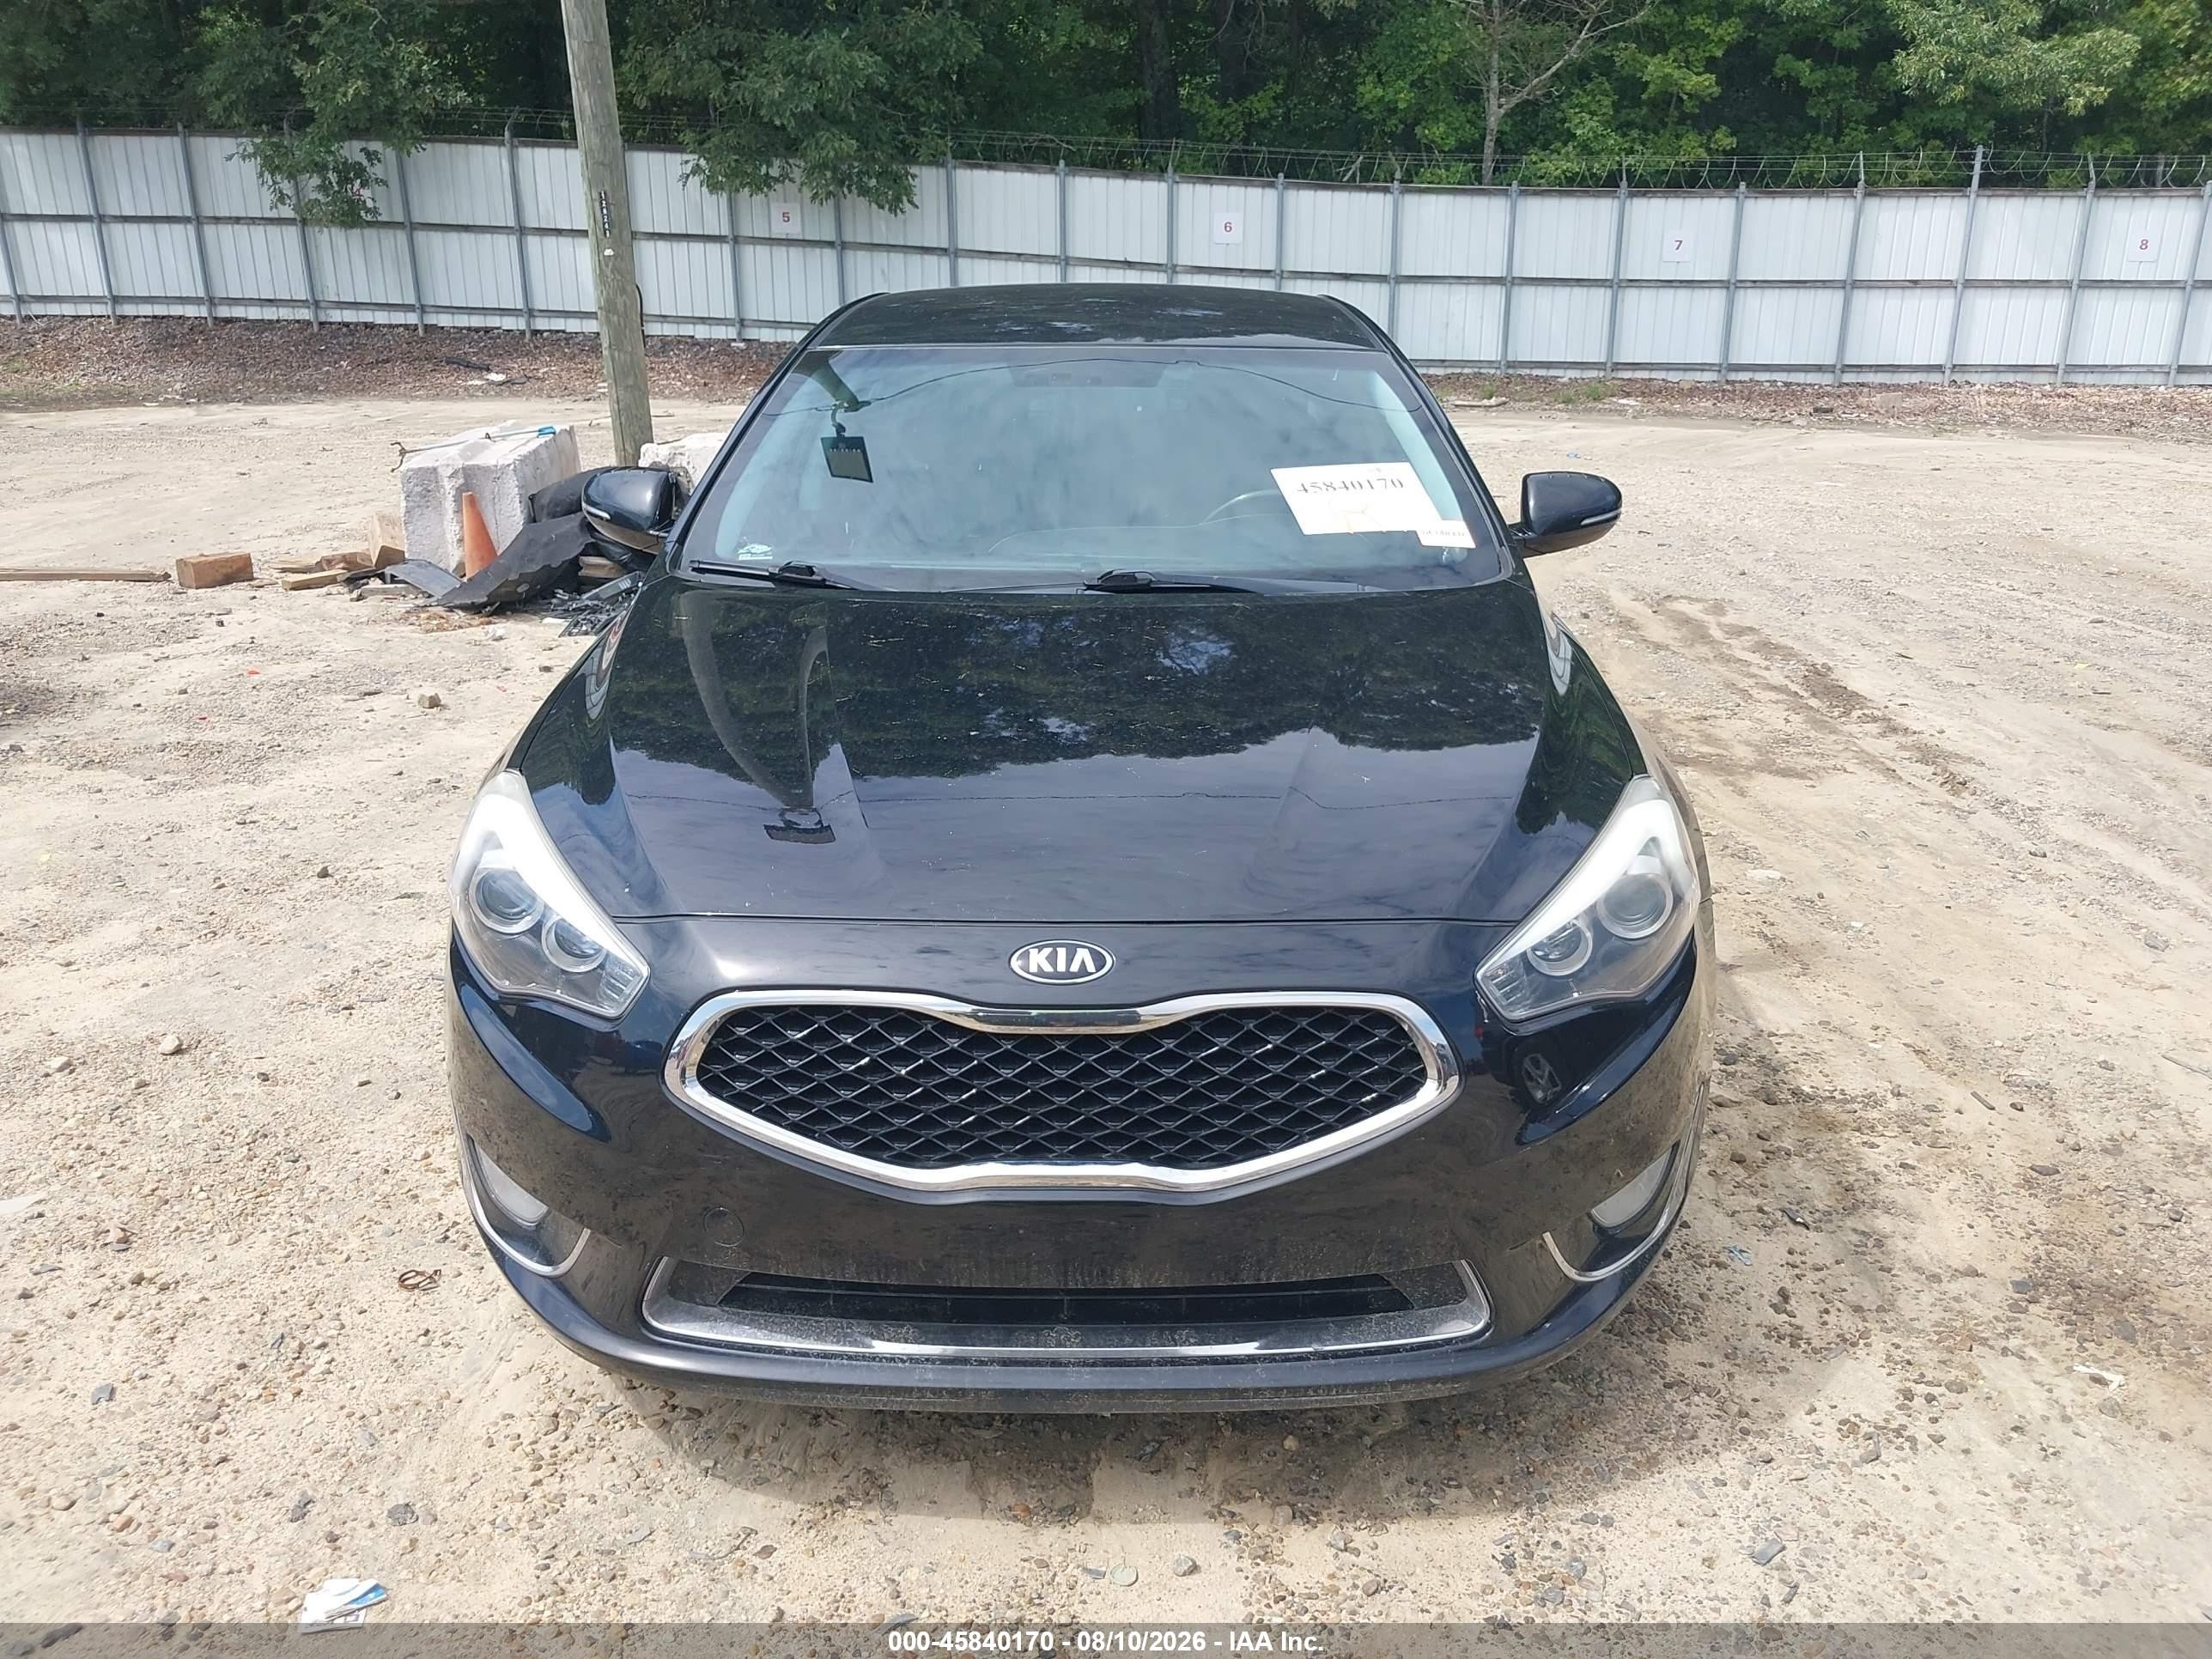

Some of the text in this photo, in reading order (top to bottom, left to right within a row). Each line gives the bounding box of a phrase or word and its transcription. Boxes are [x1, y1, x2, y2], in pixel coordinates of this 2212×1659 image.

[782, 211, 791, 223] 5
[1224, 221, 1233, 233] 6
[1674, 240, 1683, 251] 7
[2139, 239, 2149, 251] 8
[1297, 477, 1405, 494] 45840170
[1029, 947, 1097, 973] KIA
